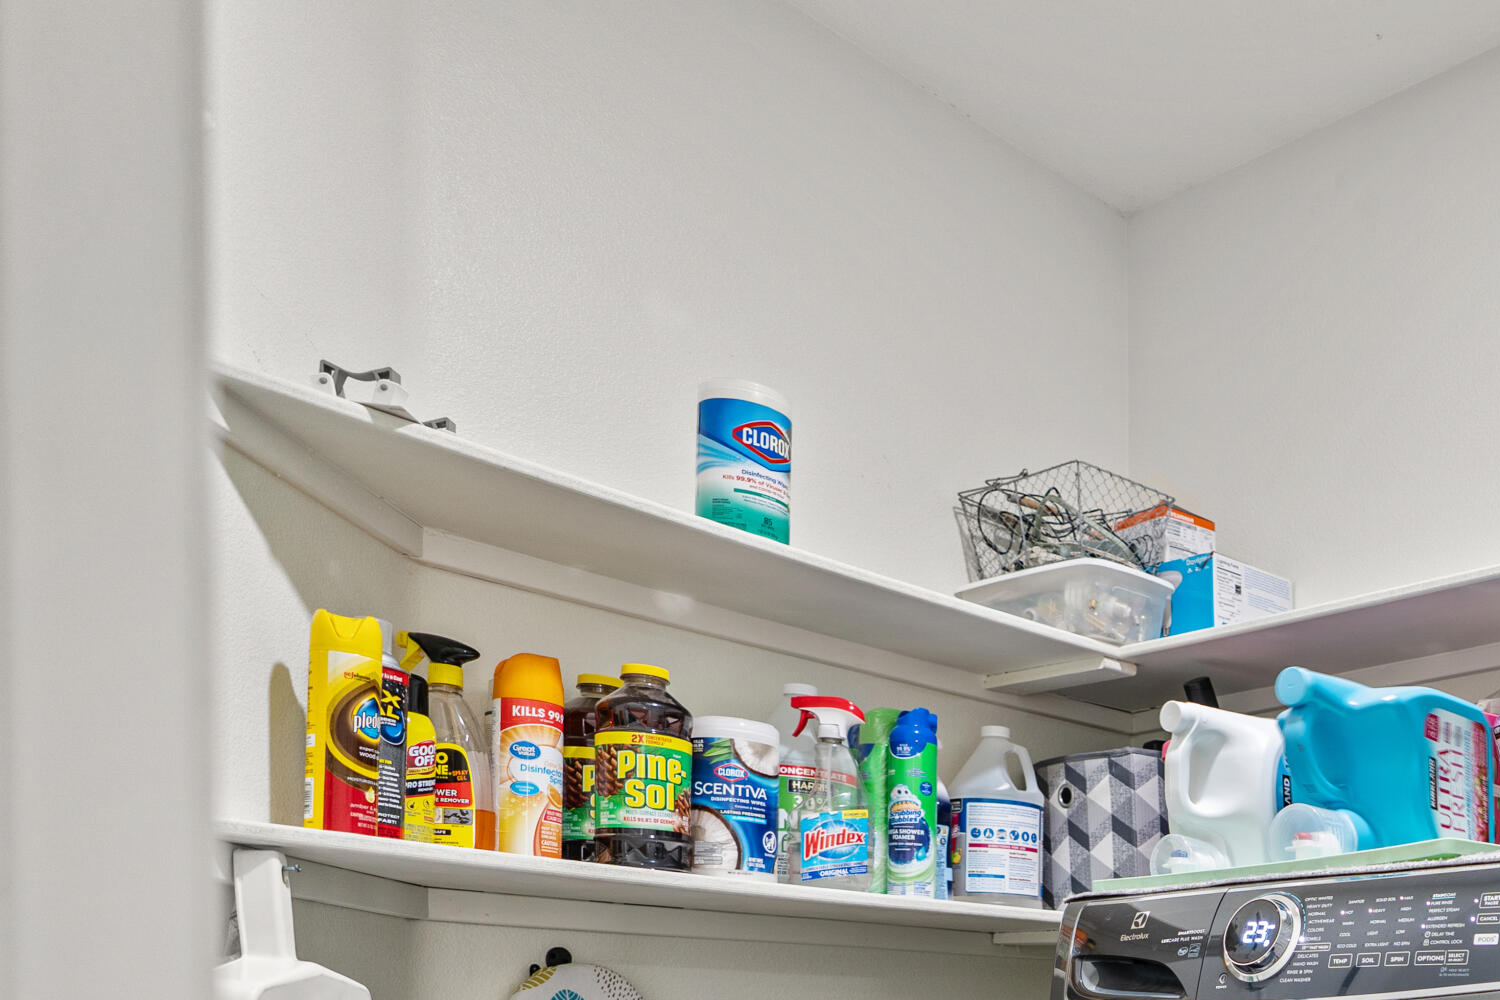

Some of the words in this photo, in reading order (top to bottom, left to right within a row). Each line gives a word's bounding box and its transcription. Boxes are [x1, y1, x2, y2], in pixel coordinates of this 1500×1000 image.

[742, 427, 789, 460] CLOROX
[735, 475, 757, 485] 99.9%
[741, 469, 777, 484] Disinfecting
[512, 705, 545, 718] KILLS
[548, 710, 564, 724] 99.9
[353, 712, 380, 733] pled
[631, 734, 644, 743] 2X
[512, 744, 535, 754] Great
[414, 755, 435, 767] OFF
[520, 763, 562, 777] Disinfecta
[718, 768, 745, 778] CLOROX
[624, 778, 675, 811] Sol
[694, 781, 767, 801] SCENTIVA
[1437, 749, 1452, 829] ULTRA
[710, 796, 749, 804] DISINFECTING
[750, 799, 766, 807] WIPES
[889, 809, 922, 818] Scrubbing
[890, 815, 919, 823] Bubbles
[804, 827, 866, 862] Windex
[819, 868, 849, 877] ORIGINAL
[1120, 932, 1149, 942] Electrolux
[1417, 954, 1444, 962] OPTIONS
